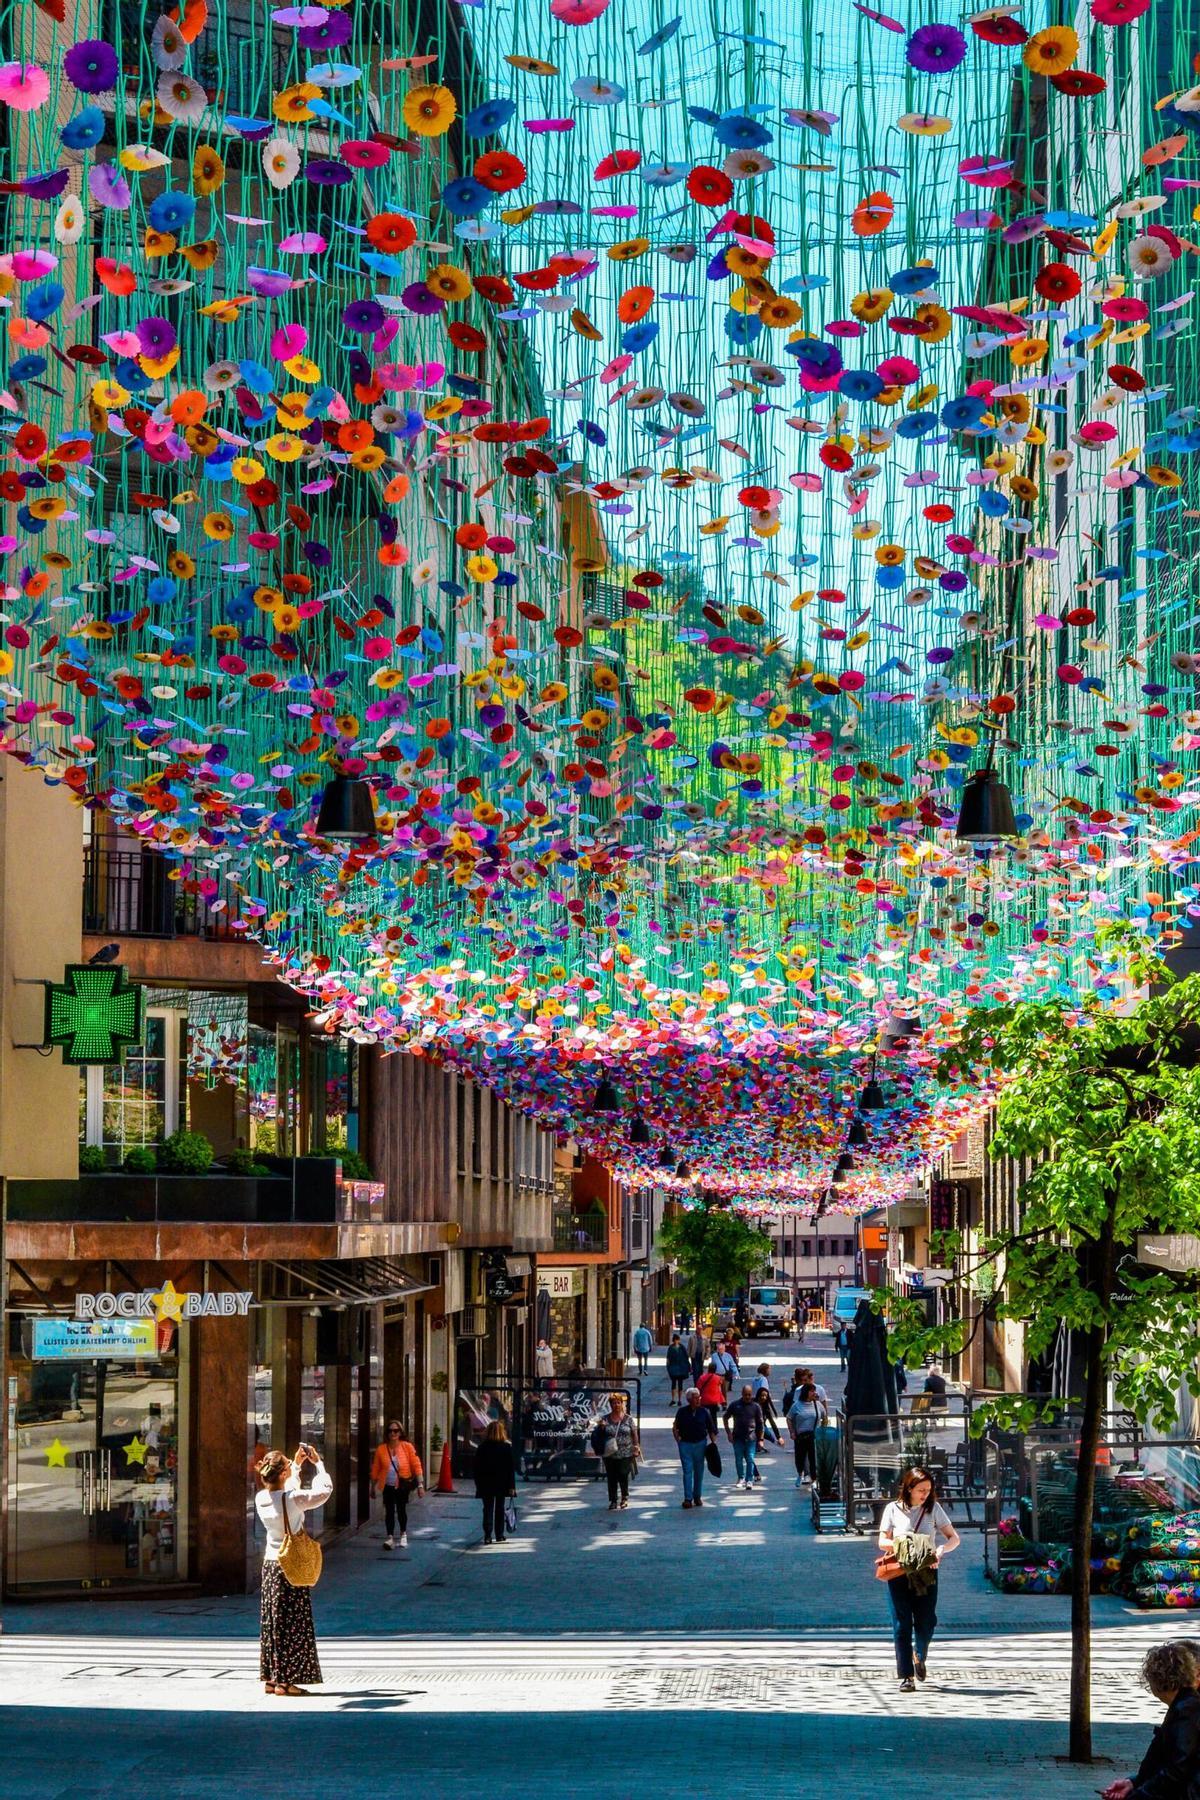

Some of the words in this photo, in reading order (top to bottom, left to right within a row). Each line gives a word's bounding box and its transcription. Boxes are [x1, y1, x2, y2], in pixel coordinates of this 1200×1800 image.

[553, 1276, 569, 1292] BAR
[76, 1293, 155, 1318] ROCK
[184, 1291, 254, 1316] BABY
[43, 1338, 69, 1346] LLISTES
